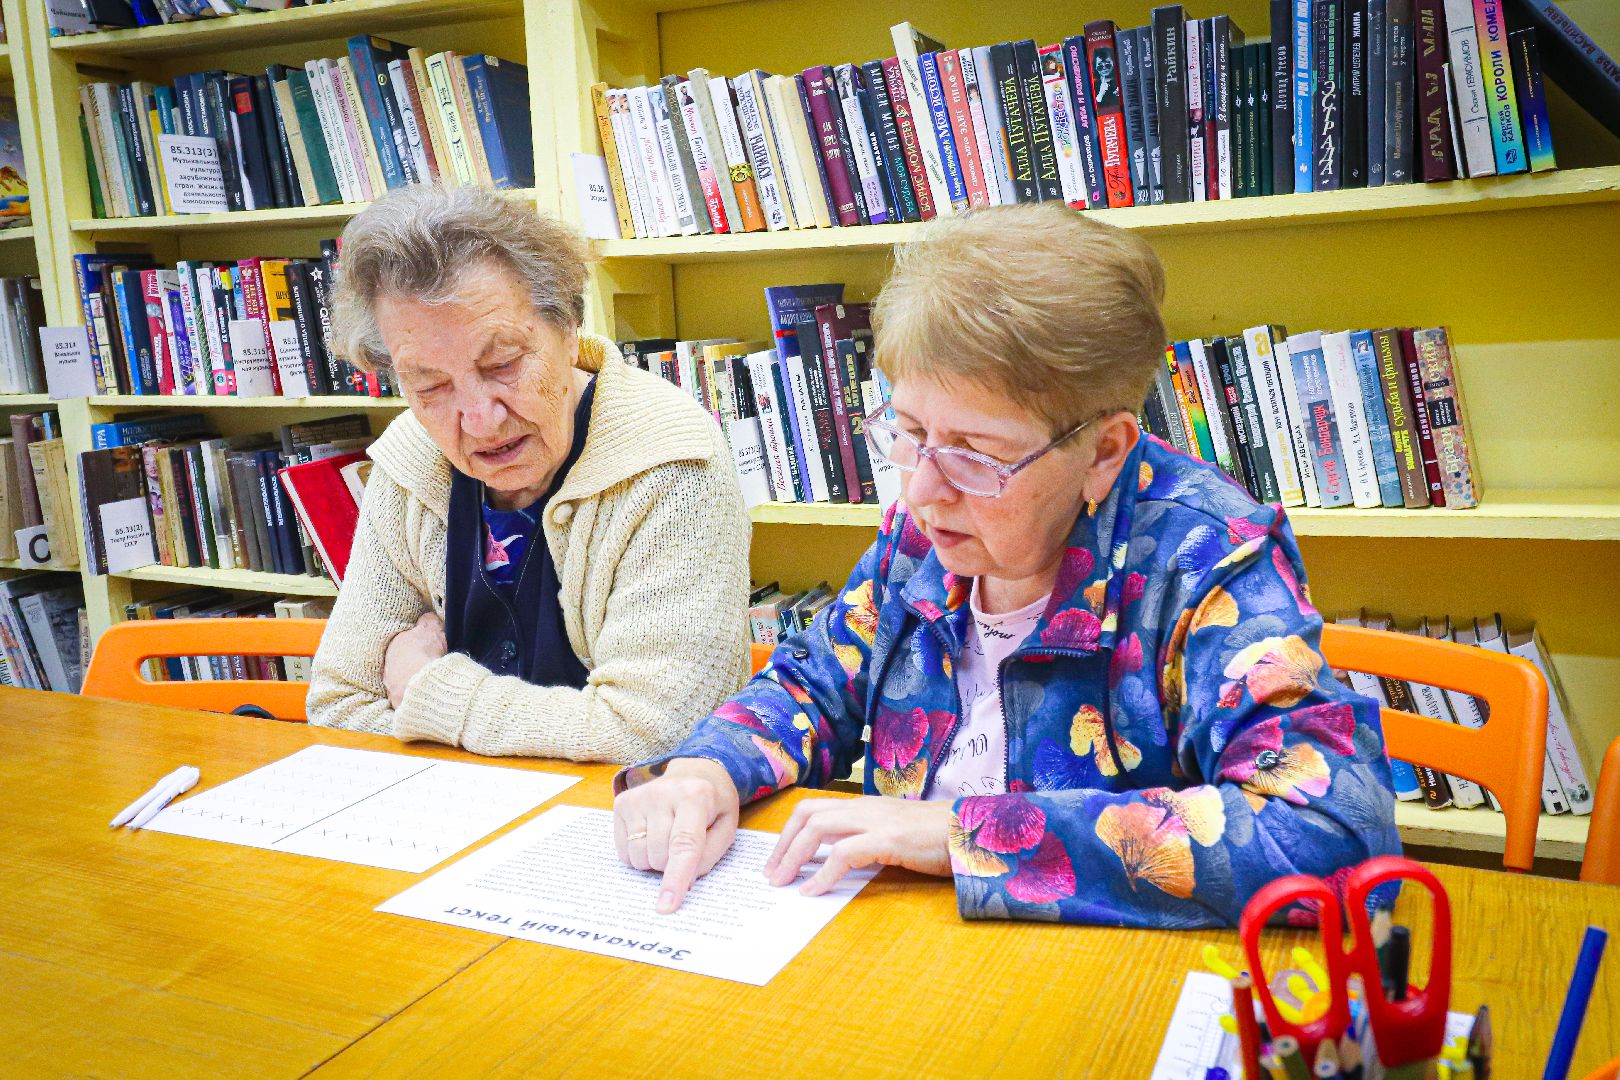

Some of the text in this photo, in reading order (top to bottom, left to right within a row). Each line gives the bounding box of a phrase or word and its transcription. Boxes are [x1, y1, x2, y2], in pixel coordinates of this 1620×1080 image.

[1352, 12, 1362, 96] ДМИТРИЙ ШЕПЕЛЕВ ЖАННА
[1544, 6, 1596, 54] ВАСИЛЬЕВЫ
[1165, 27, 1178, 82] Райкин
[1274, 46, 1288, 110] Леонид Утесов
[1460, 38, 1477, 88] ГЕРАСИМОВ
[1490, 50, 1507, 101] КОРОЛИ
[885, 64, 901, 103] ПТИЧКА
[923, 58, 941, 107] ИСТОРИЯ
[177, 89, 199, 135] ШОСТАКОВИЧ
[195, 88, 212, 134] ШОСТАКОВИЧ
[956, 108, 968, 134] ЭДИТ
[1001, 76, 1031, 182] АЛЛА ПУГАЧЕВА
[1024, 74, 1056, 182] АЛЛА ПУГАЧЕВА
[1498, 110, 1507, 143] Сергей
[1504, 104, 1514, 142] КАПКОВ
[170, 146, 218, 156] 85.313(3)
[900, 119, 931, 212] БОРИС МОИСЕЕВ
[180, 283, 191, 313] ПЕСНИ
[1379, 335, 1400, 379] фильмы
[1409, 363, 1423, 399] АШИМОВ
[1312, 404, 1334, 457] Бондарчук
[1388, 393, 1408, 427] судьба
[443, 906, 692, 960] Зеркальный текст
